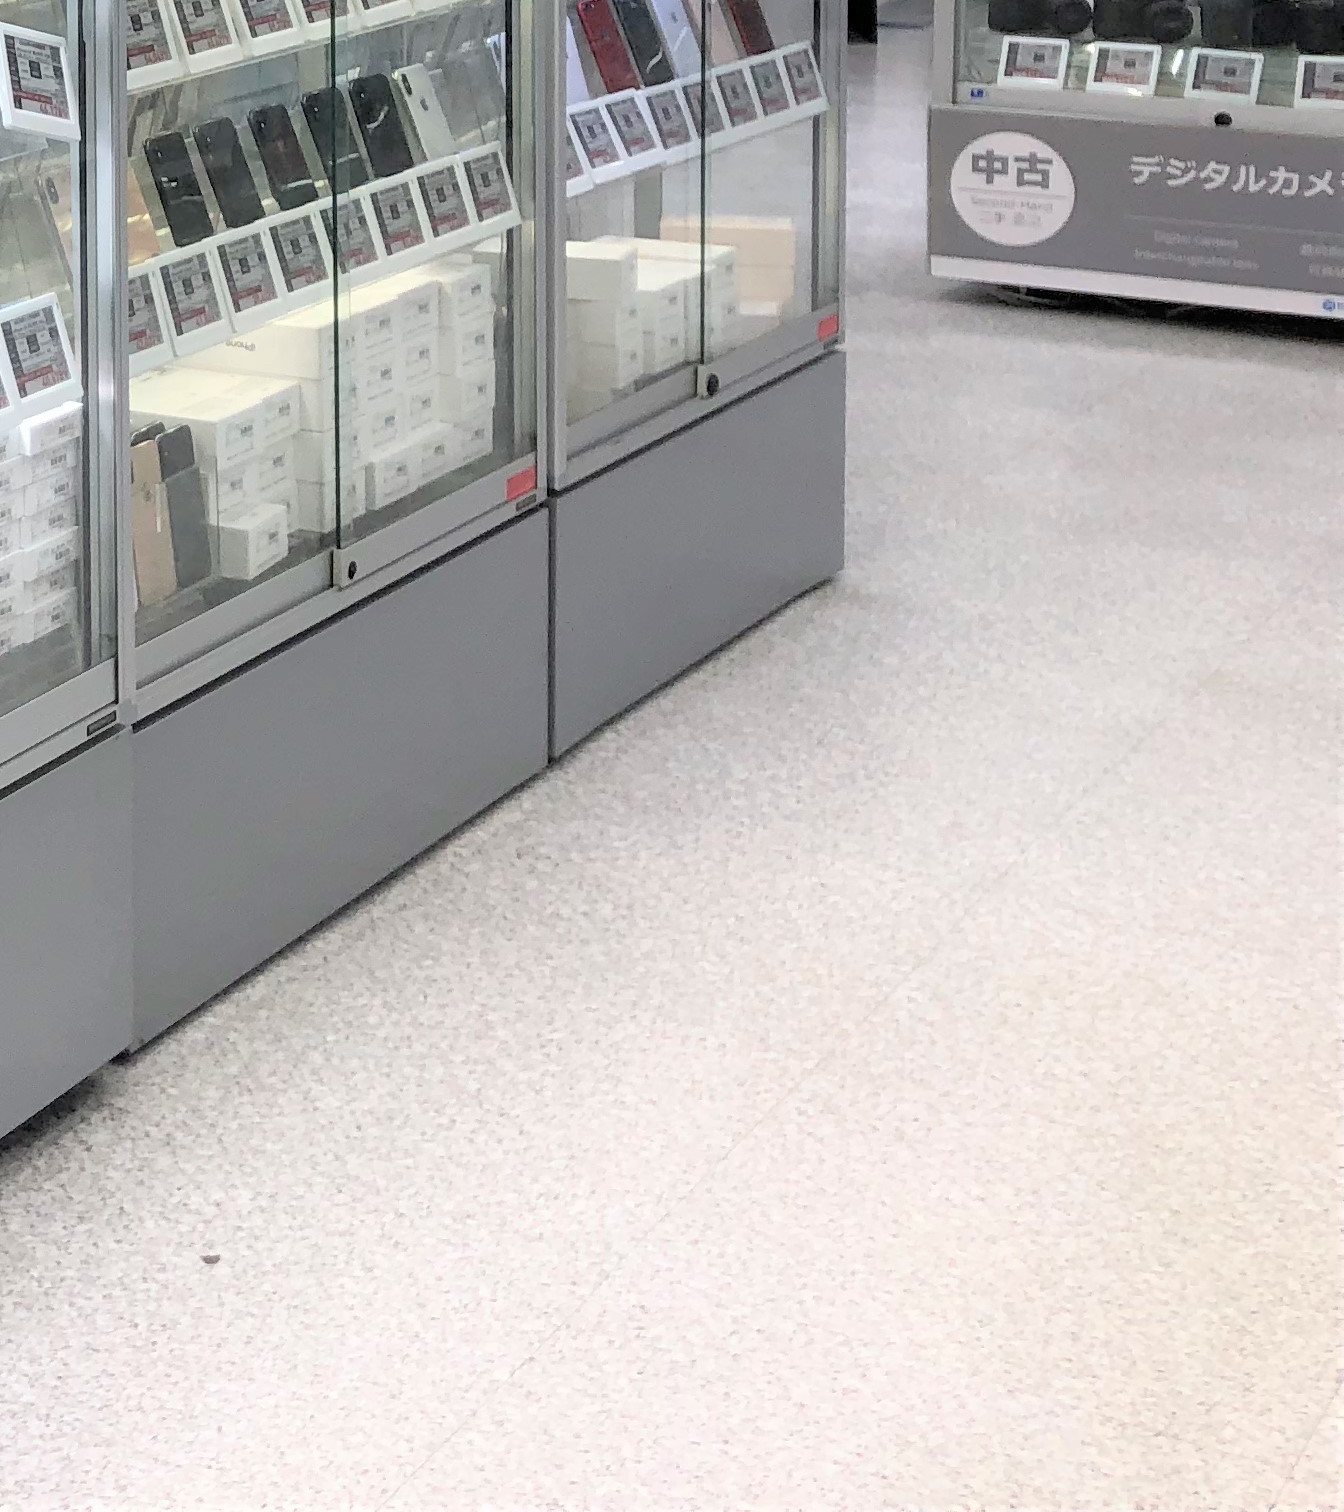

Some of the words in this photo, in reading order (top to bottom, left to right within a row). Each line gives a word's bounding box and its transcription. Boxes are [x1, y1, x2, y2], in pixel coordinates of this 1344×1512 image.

[970, 149, 1053, 190] 中古
[1129, 155, 1344, 198] デジタルカメ
